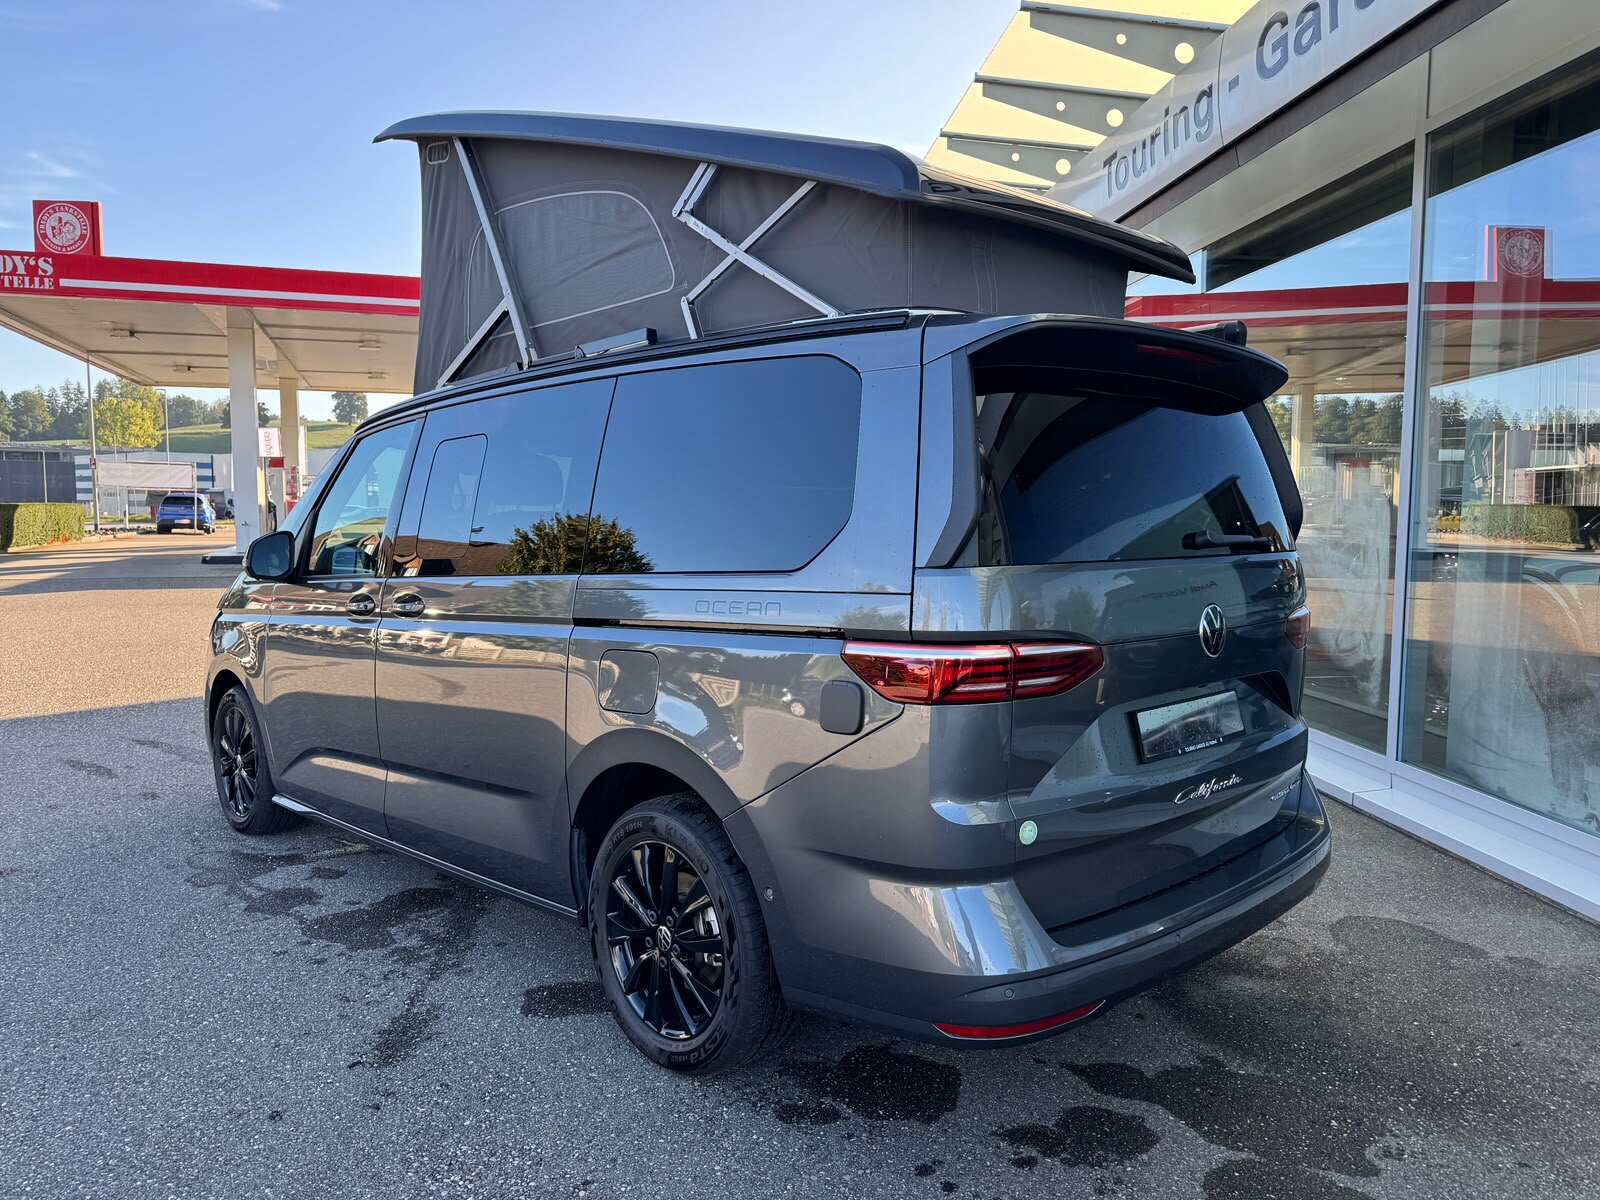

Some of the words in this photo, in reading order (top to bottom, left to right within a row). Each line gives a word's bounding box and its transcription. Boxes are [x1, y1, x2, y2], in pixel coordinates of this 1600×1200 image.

[1102, 83, 1214, 199] Touring
[1228, 74, 1240, 93] -
[1256, 0, 1375, 80] Gar
[695, 599, 782, 617] OCEAN
[1173, 773, 1243, 805] California
